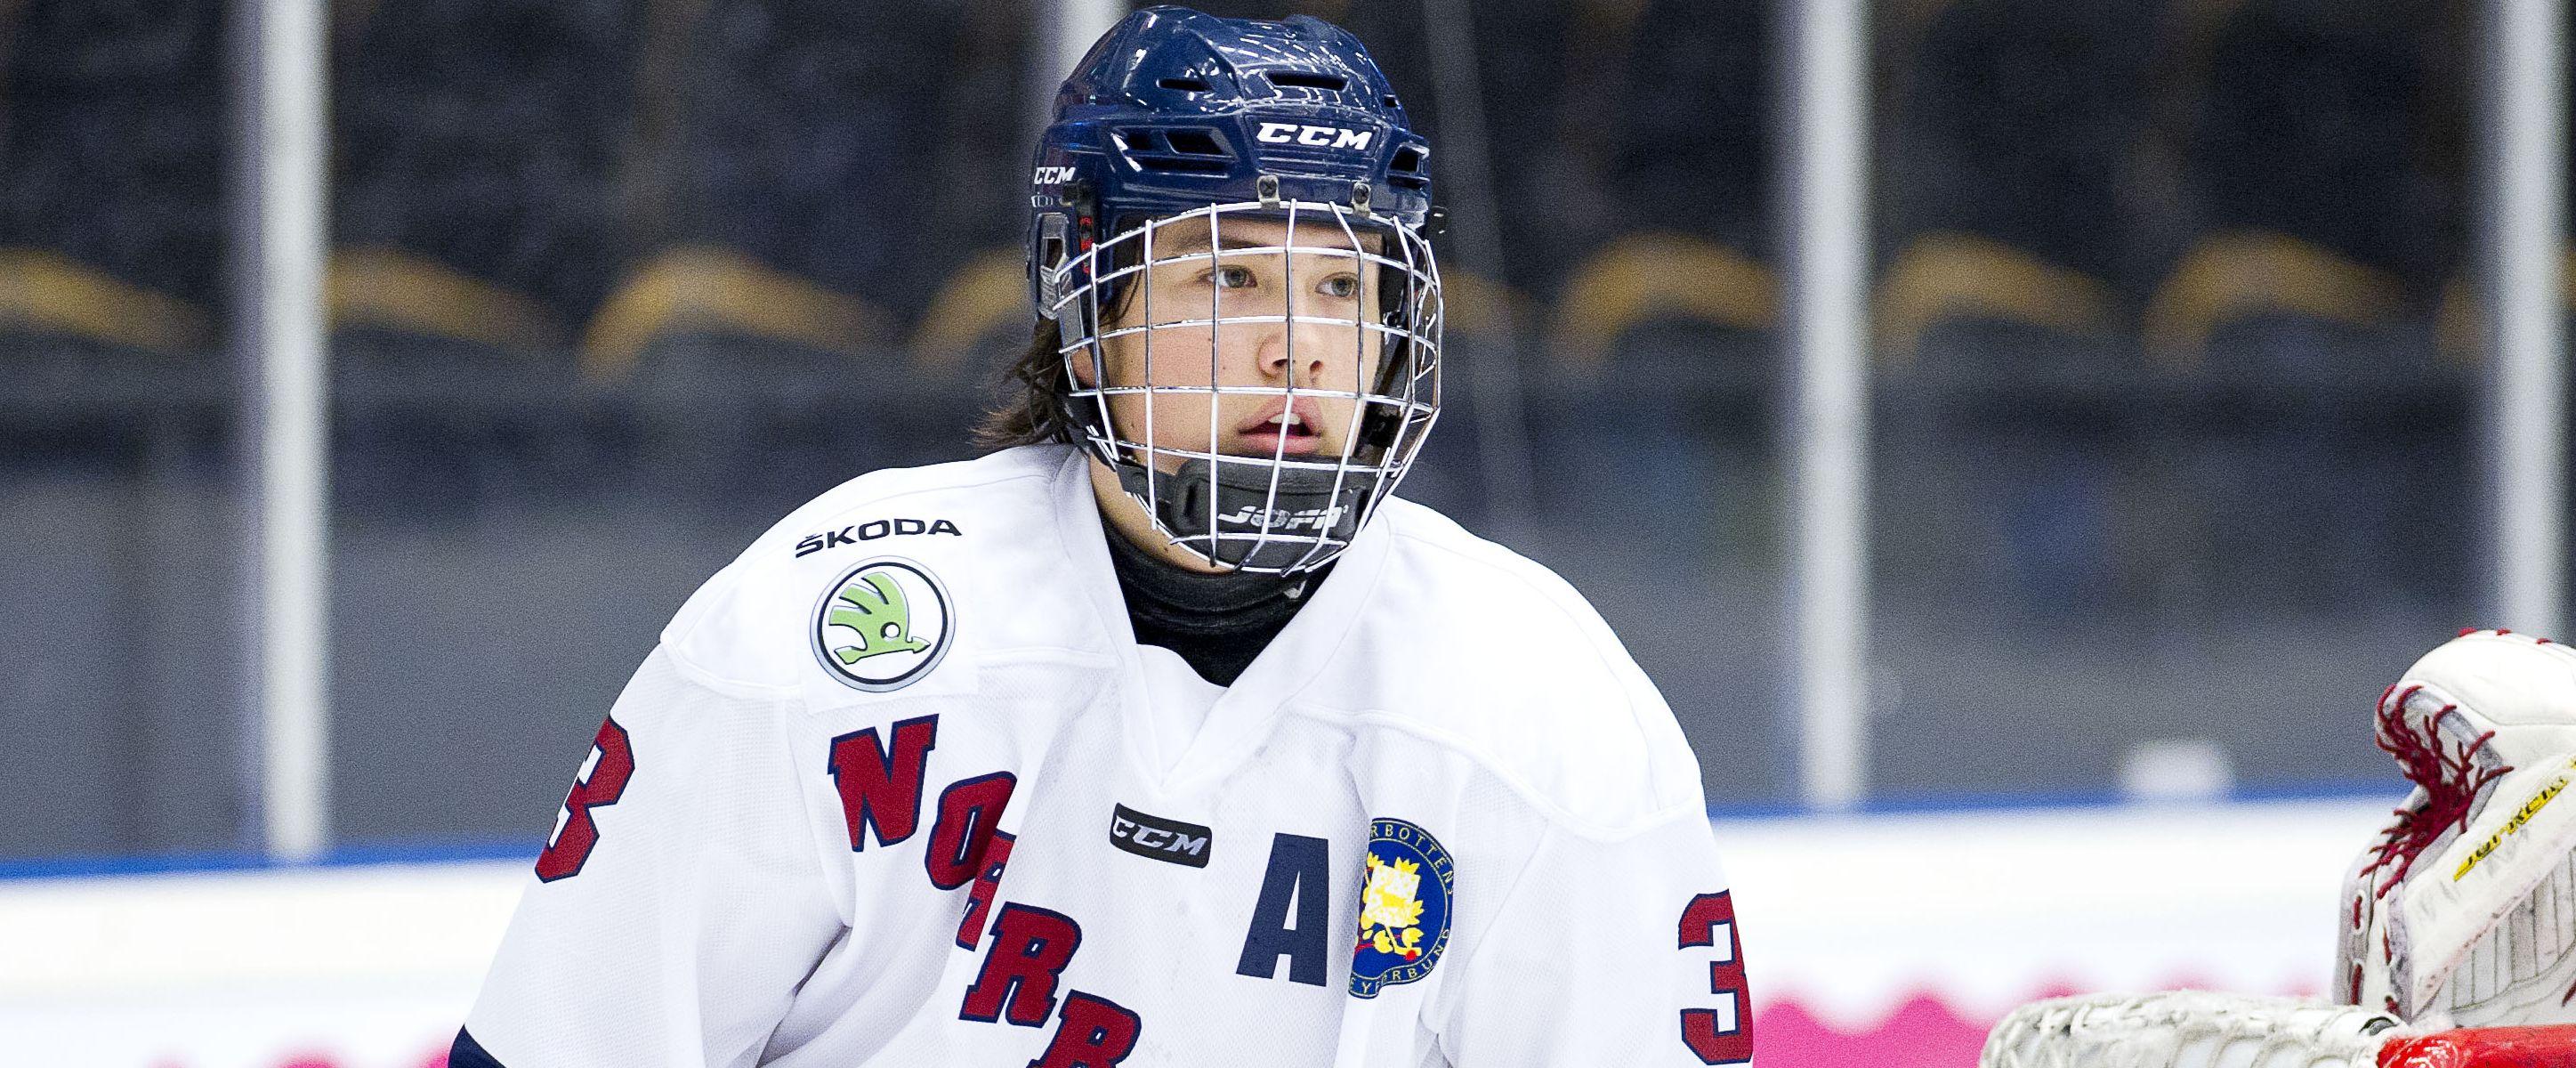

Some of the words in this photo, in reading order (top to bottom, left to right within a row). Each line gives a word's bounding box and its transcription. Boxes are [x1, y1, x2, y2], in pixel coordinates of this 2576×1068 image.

[1256, 122, 1372, 150] CCM
[1033, 166, 1077, 184] CCM
[795, 518, 963, 558] ŠKODA
[1217, 506, 1343, 530] JOFA
[1112, 815, 1208, 855] CCM
[1236, 832, 1329, 987] A
[1678, 888, 1754, 1065] 3
